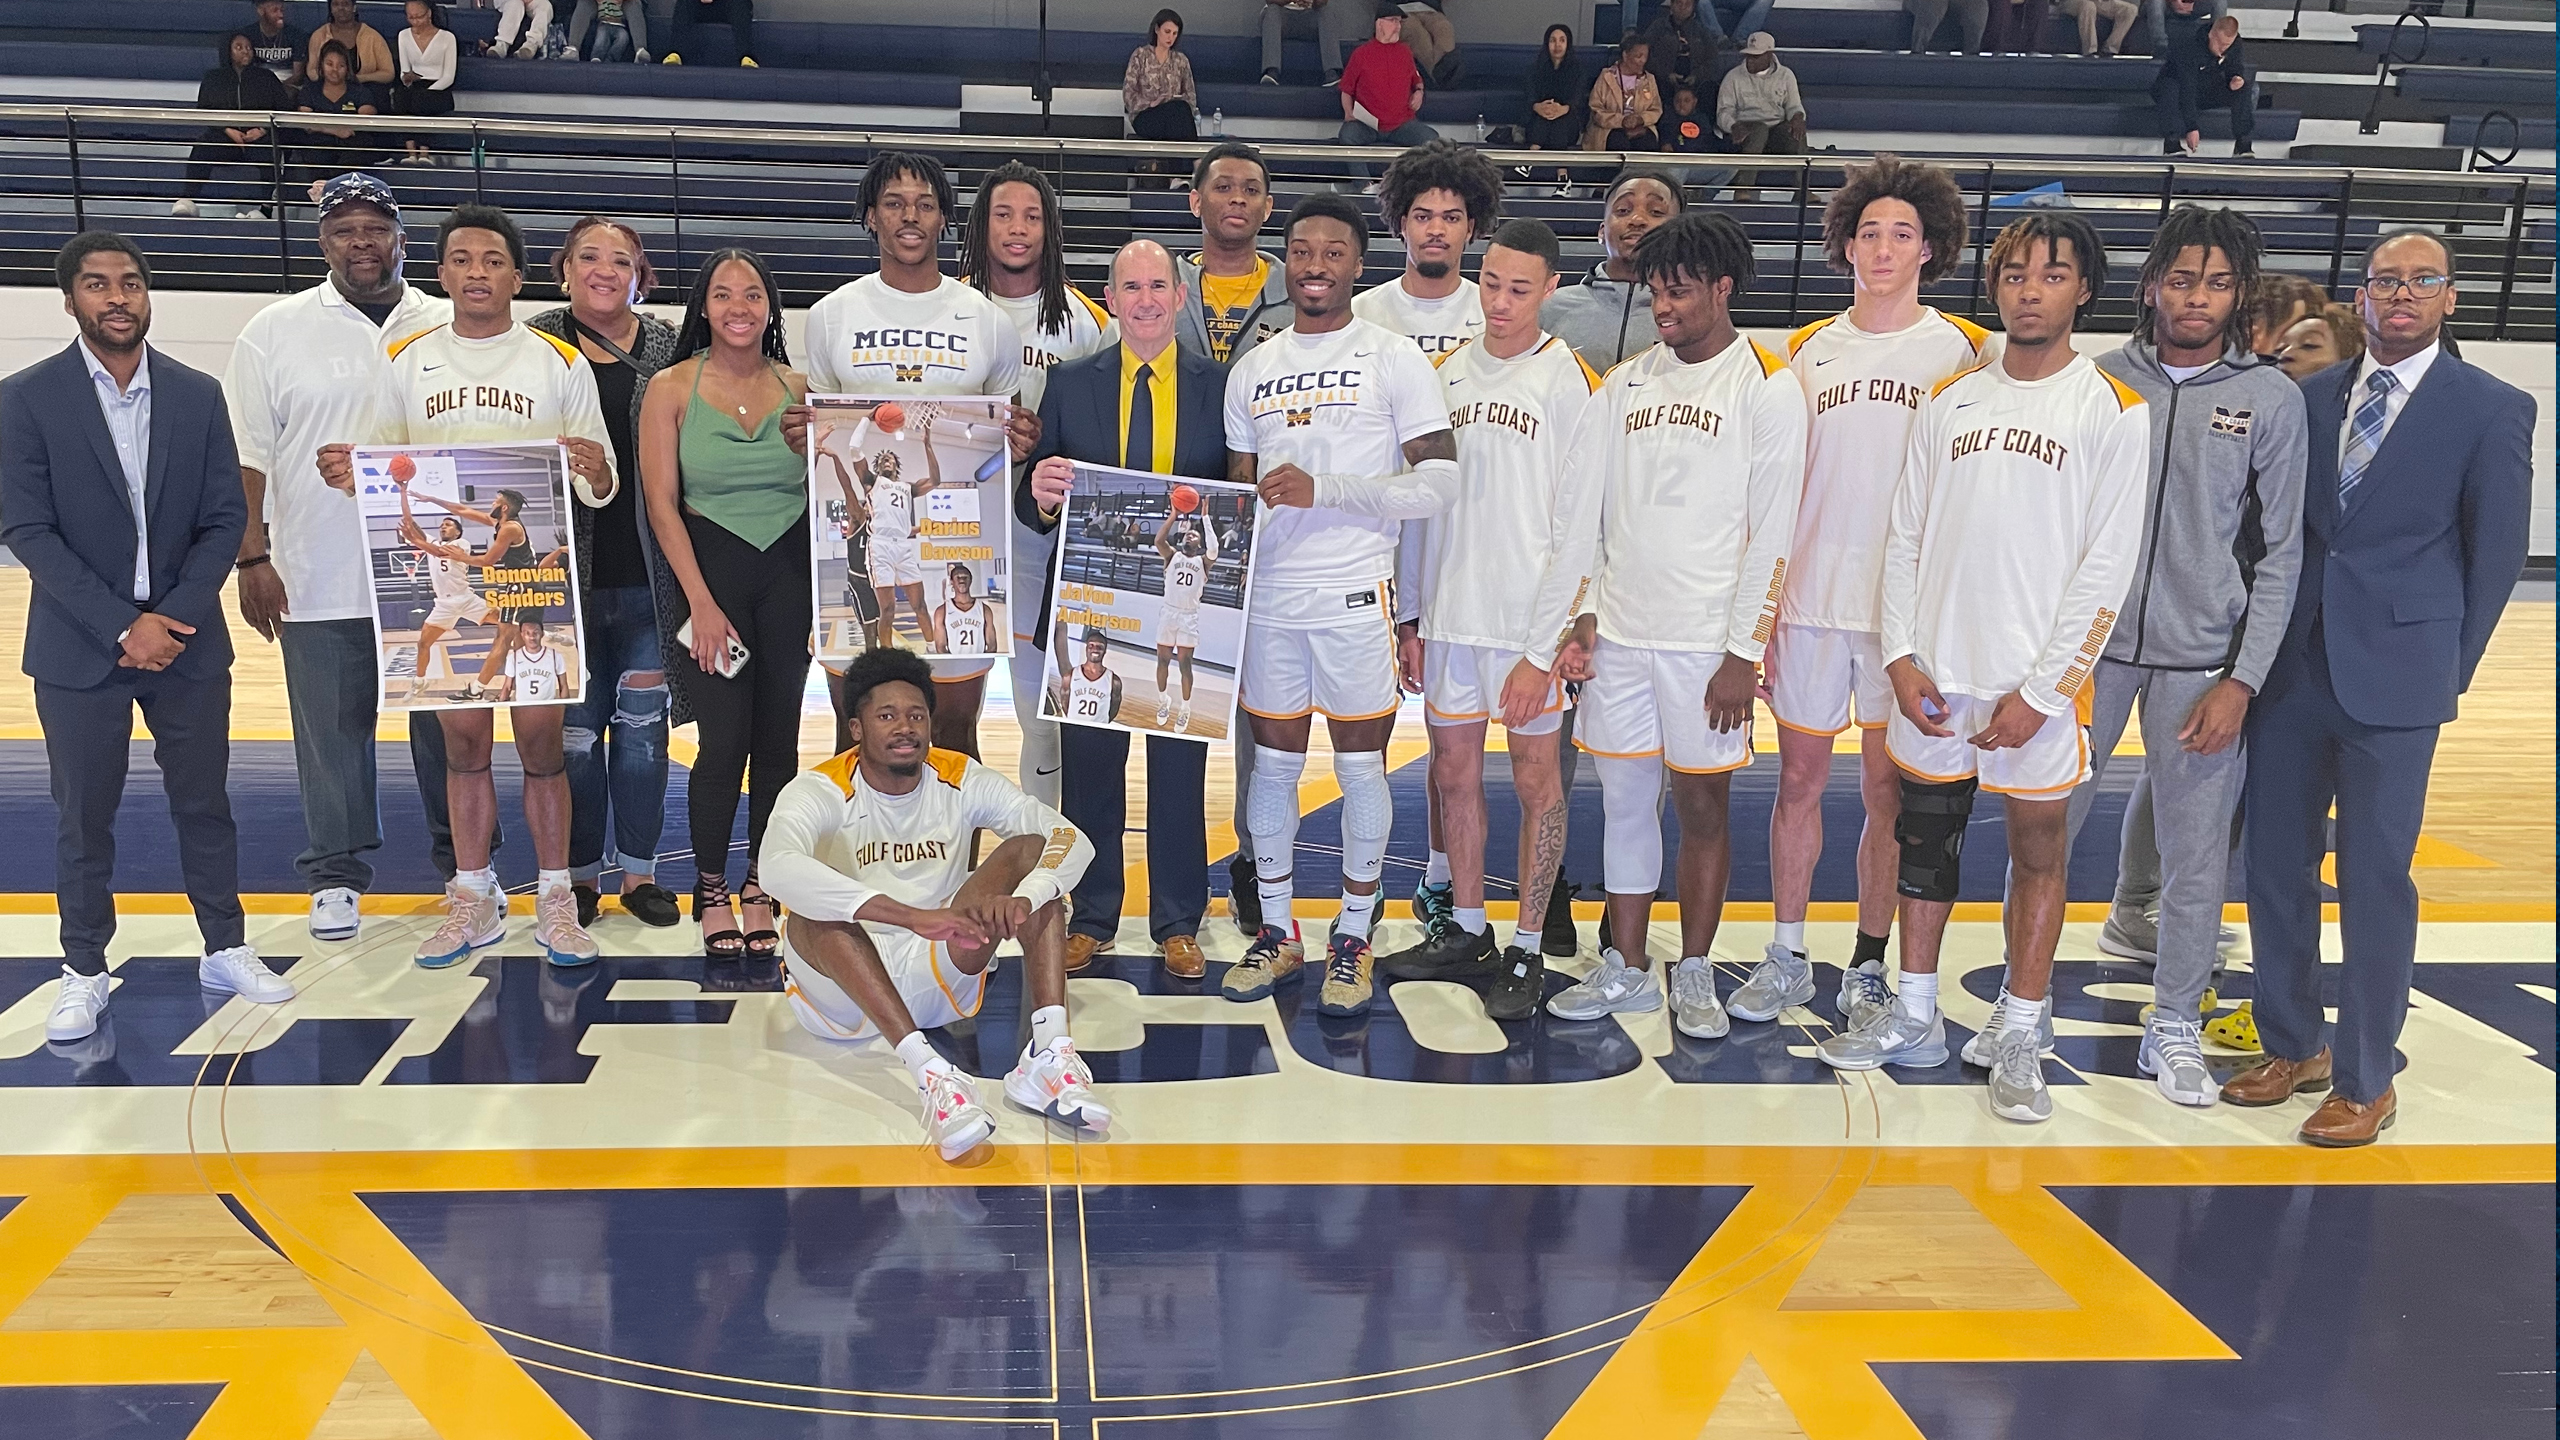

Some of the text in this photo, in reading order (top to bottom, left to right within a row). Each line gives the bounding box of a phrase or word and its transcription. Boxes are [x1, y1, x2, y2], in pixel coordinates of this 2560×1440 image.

[853, 329, 967, 353] MGCCC
[852, 349, 968, 367] BASKETBALL
[1023, 346, 1062, 370] OAS
[1252, 371, 1361, 402] MGCCC
[1817, 379, 1926, 415] GULF COAS
[426, 386, 534, 420] GULF COAST
[1251, 390, 1359, 416] BASKETBALL
[1450, 402, 1539, 441] GULF COAST
[1625, 403, 1722, 437] GULF COAST
[1951, 427, 2068, 472] GULF COAST
[890, 493, 904, 509] 21
[920, 517, 980, 537] Darius
[921, 542, 993, 561] Dawson
[441, 560, 448, 572] 5
[482, 566, 565, 584] Donovan
[1176, 572, 1193, 587] 20
[485, 588, 566, 608] Sanders
[1060, 582, 1114, 606] JaVon
[1057, 605, 1141, 632] Anderson
[960, 630, 974, 646] 21
[2055, 607, 2116, 698] BULLDOGS
[529, 680, 539, 695] 5
[1078, 700, 1098, 716] 20
[856, 840, 947, 869] GULF COAST
